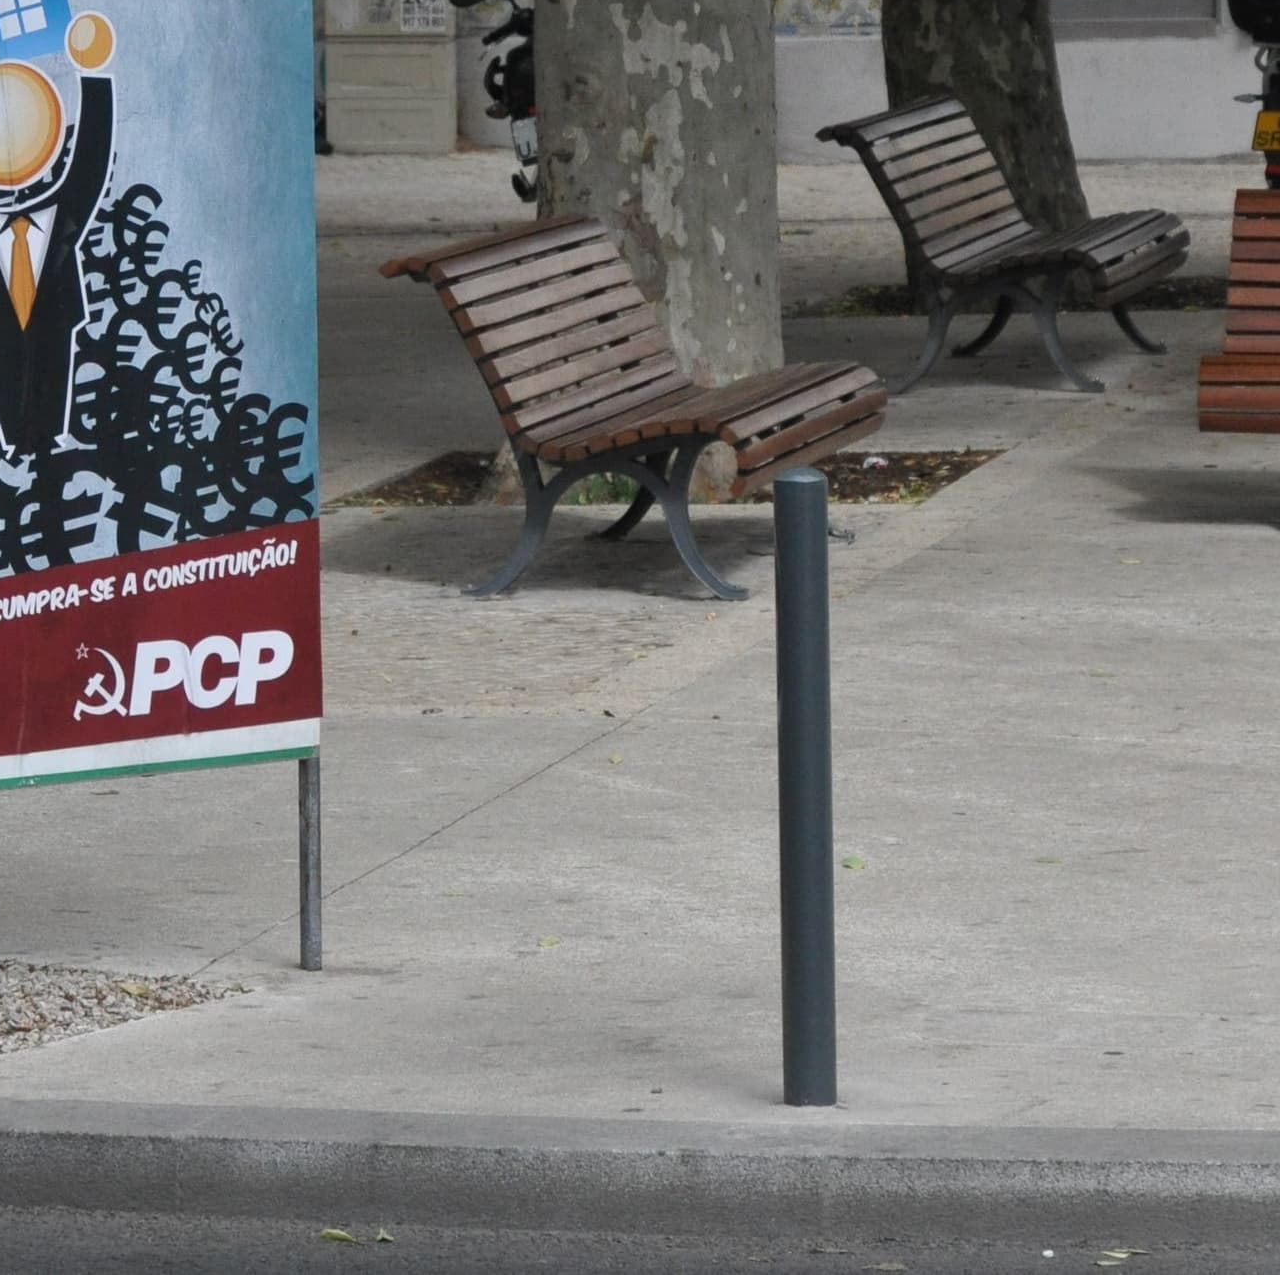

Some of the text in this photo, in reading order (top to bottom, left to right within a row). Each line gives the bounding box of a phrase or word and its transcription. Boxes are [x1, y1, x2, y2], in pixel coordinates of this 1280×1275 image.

[122, 572, 138, 596] A
[143, 537, 298, 592] CONSTITUIÇÃO!
[128, 629, 295, 717] PCP
